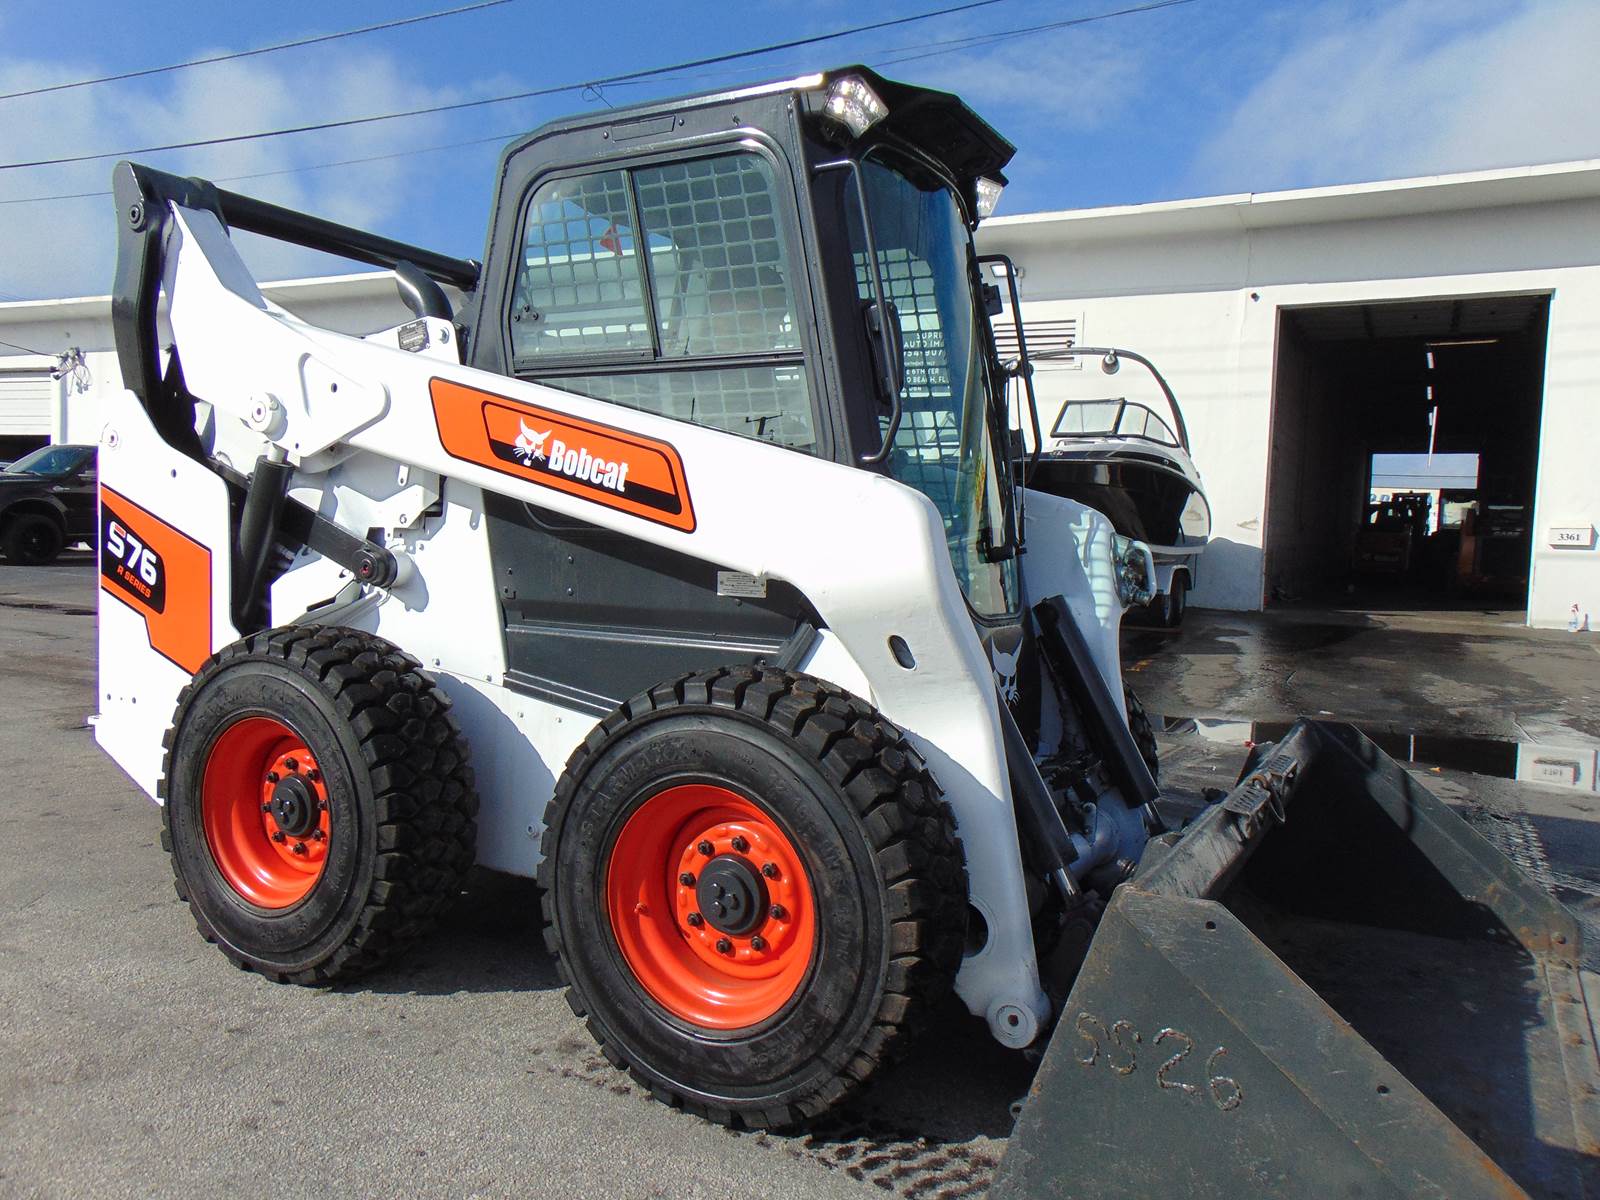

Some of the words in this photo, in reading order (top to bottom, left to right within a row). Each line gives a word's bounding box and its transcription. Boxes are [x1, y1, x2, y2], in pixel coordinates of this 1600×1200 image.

[548, 439, 629, 493] Bobcat
[107, 521, 157, 586] S76
[1558, 533, 1580, 541] 3361
[124, 571, 152, 599] SERIES
